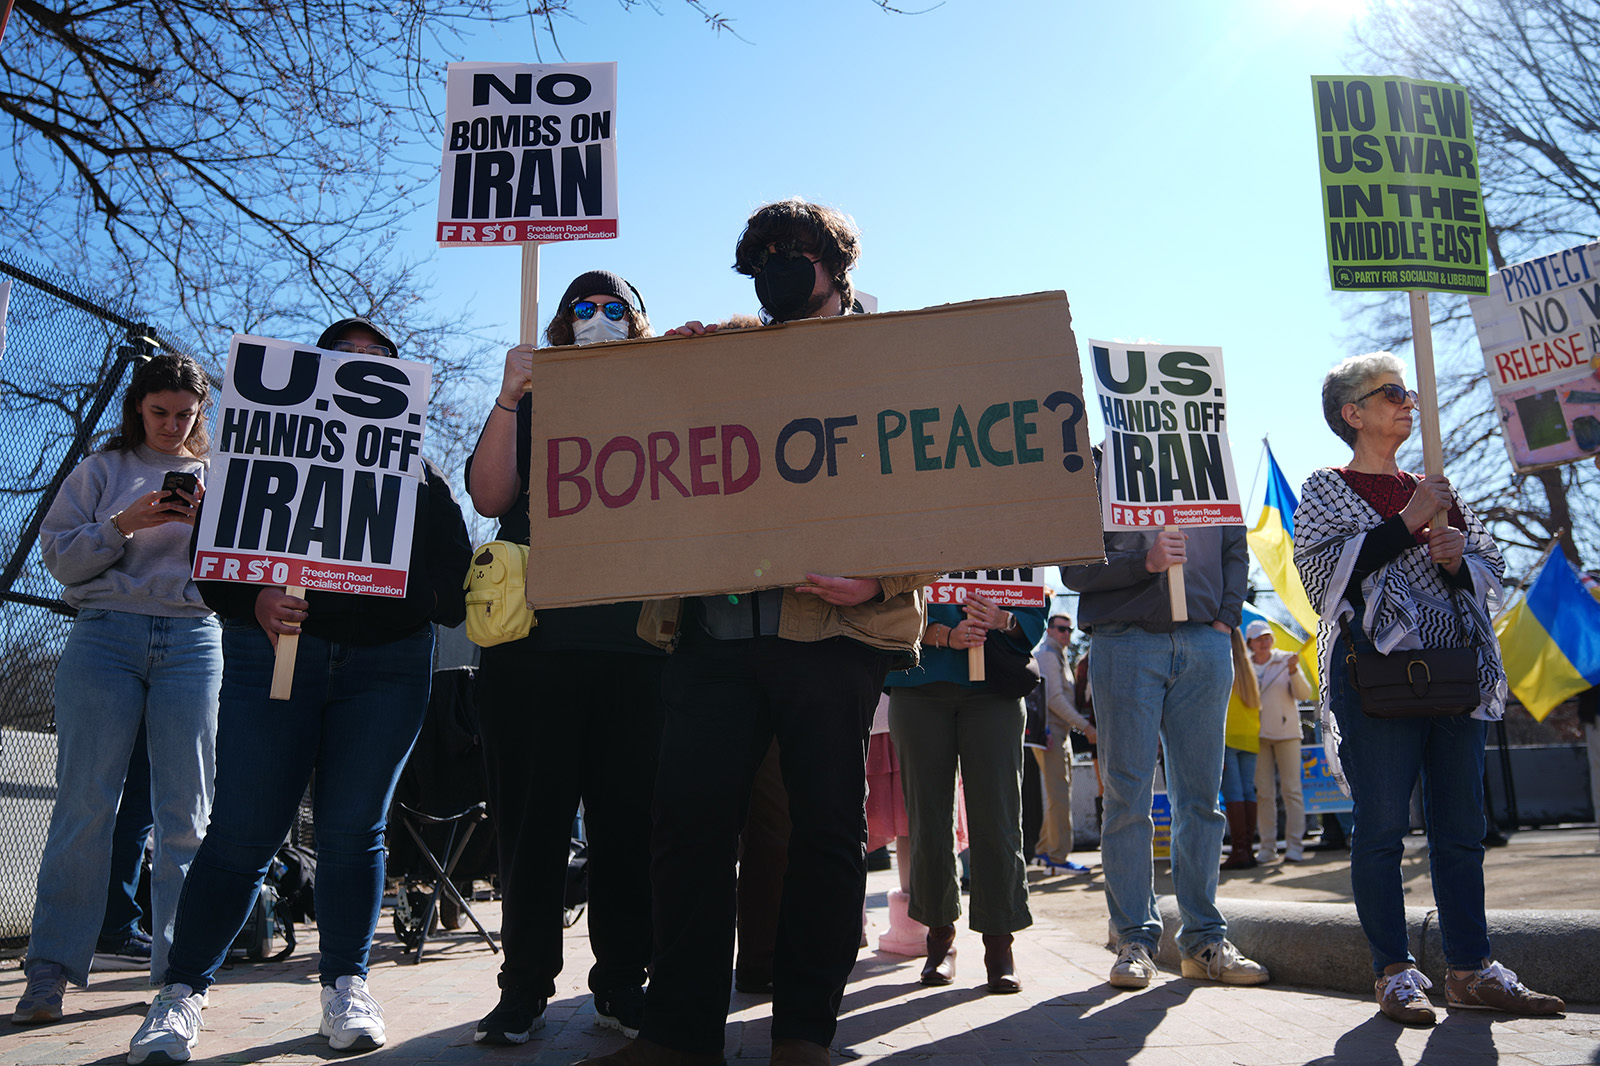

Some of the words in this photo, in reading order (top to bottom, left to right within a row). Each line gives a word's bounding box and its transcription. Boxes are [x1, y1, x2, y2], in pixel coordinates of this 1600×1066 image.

[473, 73, 592, 107] NO
[1316, 80, 1376, 132] NO
[1384, 81, 1467, 139] NEW
[449, 115, 561, 151] BOMBS
[570, 110, 611, 144] ON
[1321, 134, 1384, 174] US
[1384, 135, 1477, 180] WAR
[451, 143, 602, 219] IRAN
[1326, 183, 1384, 218] IN
[1387, 184, 1480, 223] THE
[527, 224, 565, 232] Freedom
[566, 224, 587, 232] Road
[527, 232, 562, 240] Socialist
[563, 231, 615, 240] Organization
[1329, 221, 1428, 261] MIDDLE
[1430, 222, 1481, 265] EAST
[1354, 271, 1380, 283] PARTY
[1381, 270, 1398, 283] FOR
[1400, 270, 1439, 284] SOCIALISM
[1440, 272, 1446, 284] &
[1447, 273, 1486, 288] LIBERATION
[1501, 245, 1591, 302] PROTECT
[1519, 297, 1569, 341] NO
[1092, 345, 1223, 397] U.S.
[1495, 332, 1589, 384] RELEASE
[233, 342, 421, 426] U.S.
[1098, 394, 1178, 432] HANDS
[1184, 401, 1225, 432] OFF
[219, 407, 347, 463] HANDS
[356, 424, 421, 472] OFF
[546, 424, 761, 519] BORED
[775, 414, 858, 484] OF
[877, 391, 1084, 475] PEACE?
[1111, 430, 1229, 502] IRAN
[214, 457, 402, 565] IRAN
[1172, 508, 1203, 516] Freedom
[1203, 508, 1221, 516] Road
[1173, 516, 1202, 524] Socialist
[1202, 515, 1242, 525] Organization
[300, 566, 346, 580] Freedom
[347, 572, 372, 583] Road
[300, 577, 341, 590] Socialist
[342, 582, 403, 595] Organization
[975, 588, 1005, 596] Freedom
[1005, 589, 1023, 597] Road
[1003, 597, 1043, 606] Organization
